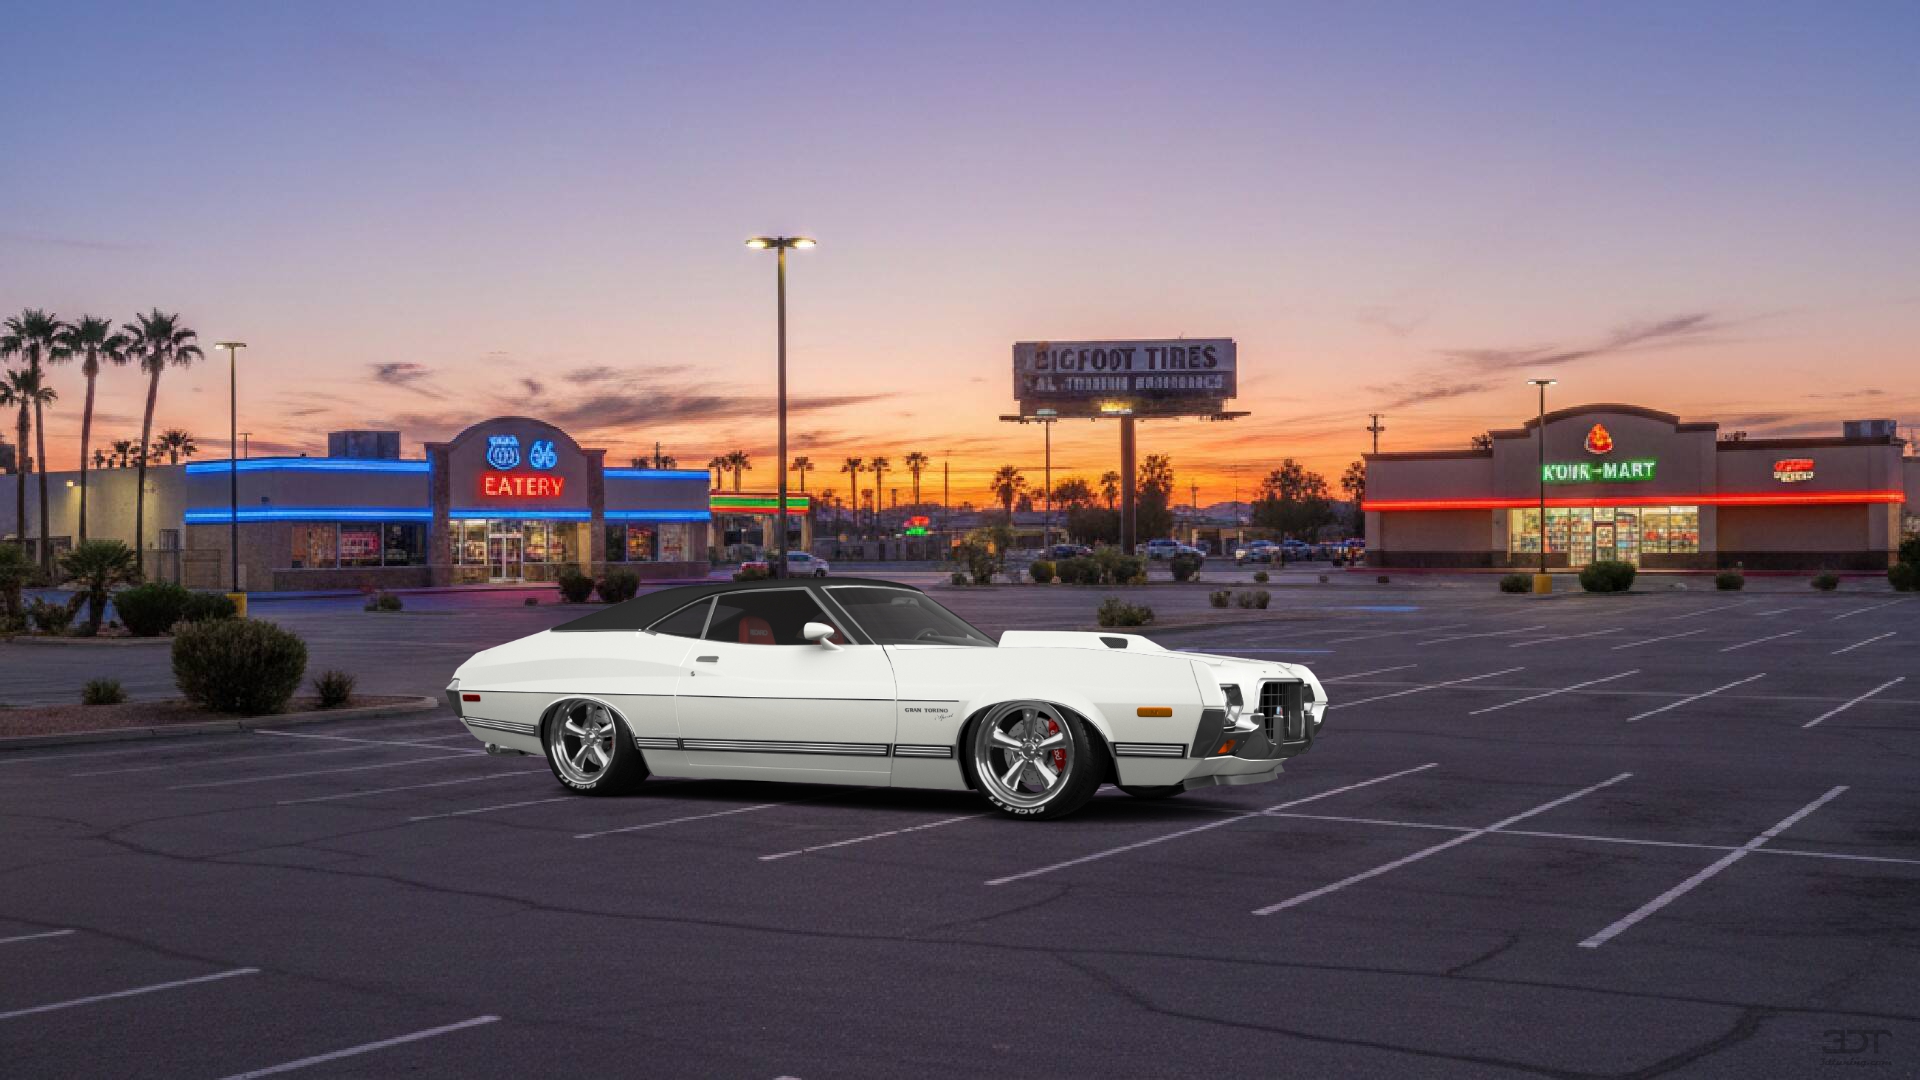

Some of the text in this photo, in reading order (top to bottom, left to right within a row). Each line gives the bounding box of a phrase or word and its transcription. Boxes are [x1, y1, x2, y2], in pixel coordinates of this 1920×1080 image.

[485, 475, 566, 496] EATERY
[568, 782, 597, 790] EAGLE
[988, 795, 1046, 815] EAGLE F1
